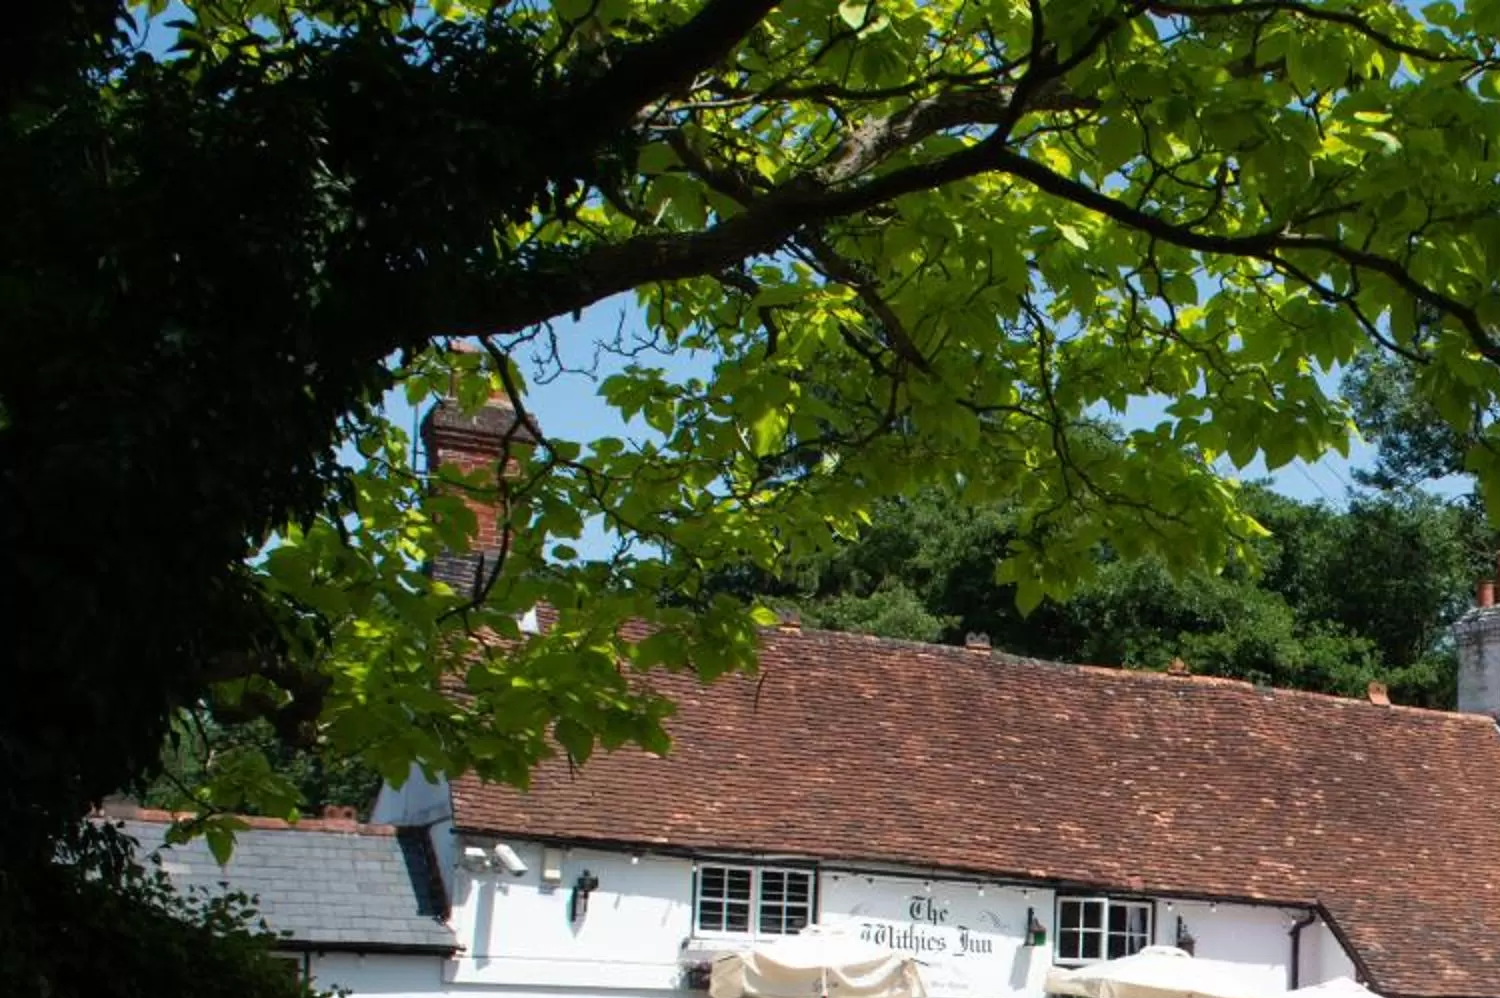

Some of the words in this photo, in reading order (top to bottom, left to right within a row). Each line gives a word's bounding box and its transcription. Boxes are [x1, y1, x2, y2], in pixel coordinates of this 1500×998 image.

[909, 895, 949, 925] The
[860, 923, 947, 954] Withies
[952, 925, 993, 956] Inn
